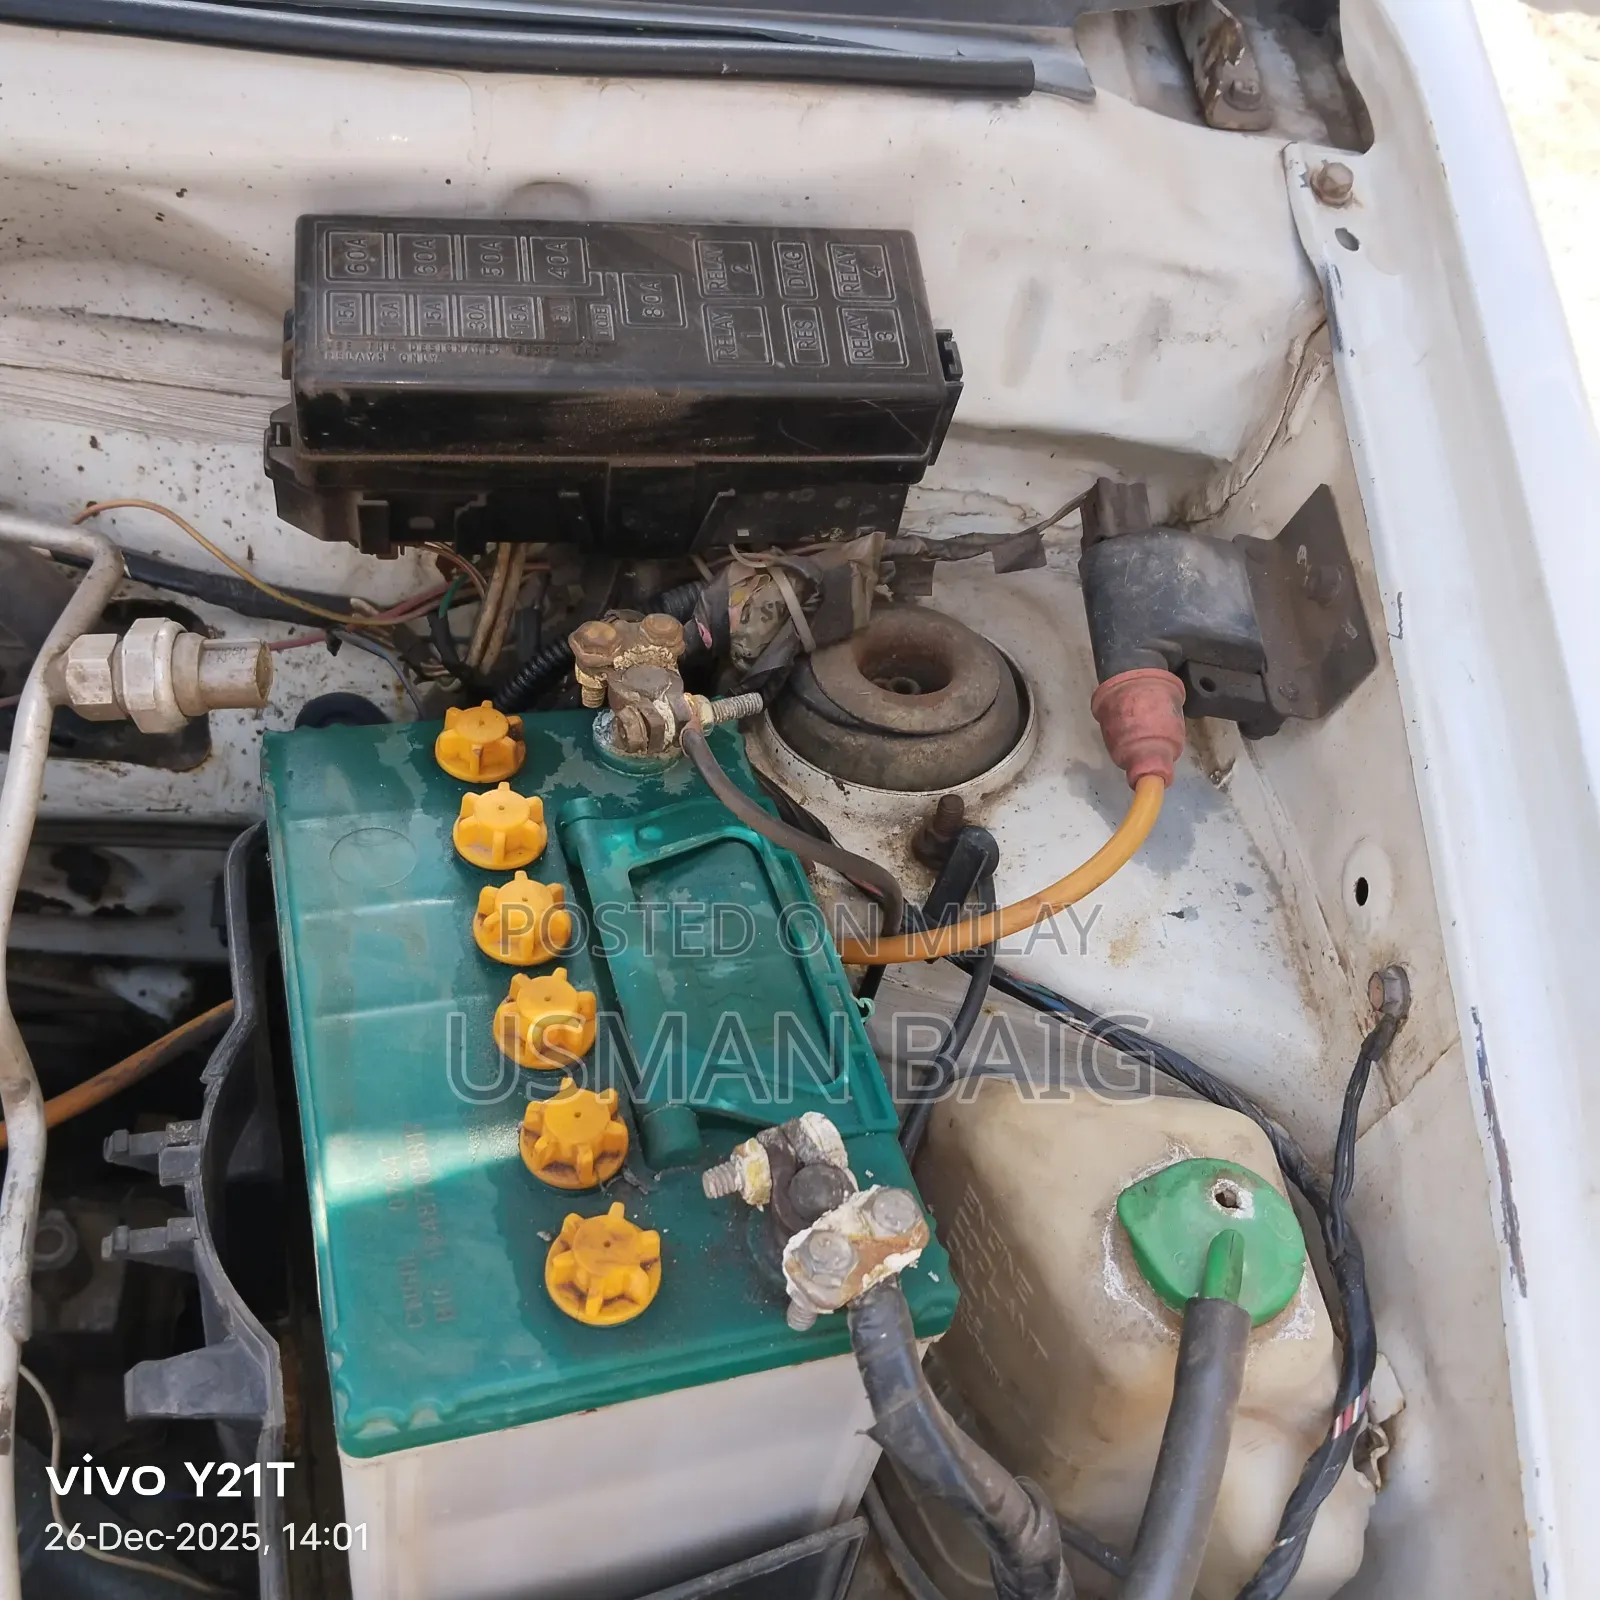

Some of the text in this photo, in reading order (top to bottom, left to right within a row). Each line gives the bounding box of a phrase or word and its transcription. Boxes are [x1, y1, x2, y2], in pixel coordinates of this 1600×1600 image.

[344, 238, 368, 275] 60A
[478, 240, 504, 277] 50A
[545, 242, 569, 279] 40A
[702, 248, 731, 291] RELAY
[731, 263, 753, 275] 2
[782, 251, 809, 289] DIAG
[835, 249, 863, 294] RELAY
[862, 264, 884, 279] 4
[337, 301, 355, 326] 15A
[380, 302, 400, 327] 15A
[425, 302, 443, 328] 15A
[510, 303, 530, 329] 15A
[639, 281, 665, 318] 80A
[467, 303, 488, 330] 30A
[711, 312, 739, 360] RELAY
[793, 320, 821, 350] RES
[844, 312, 875, 361] RELAY
[874, 331, 898, 342] 3
